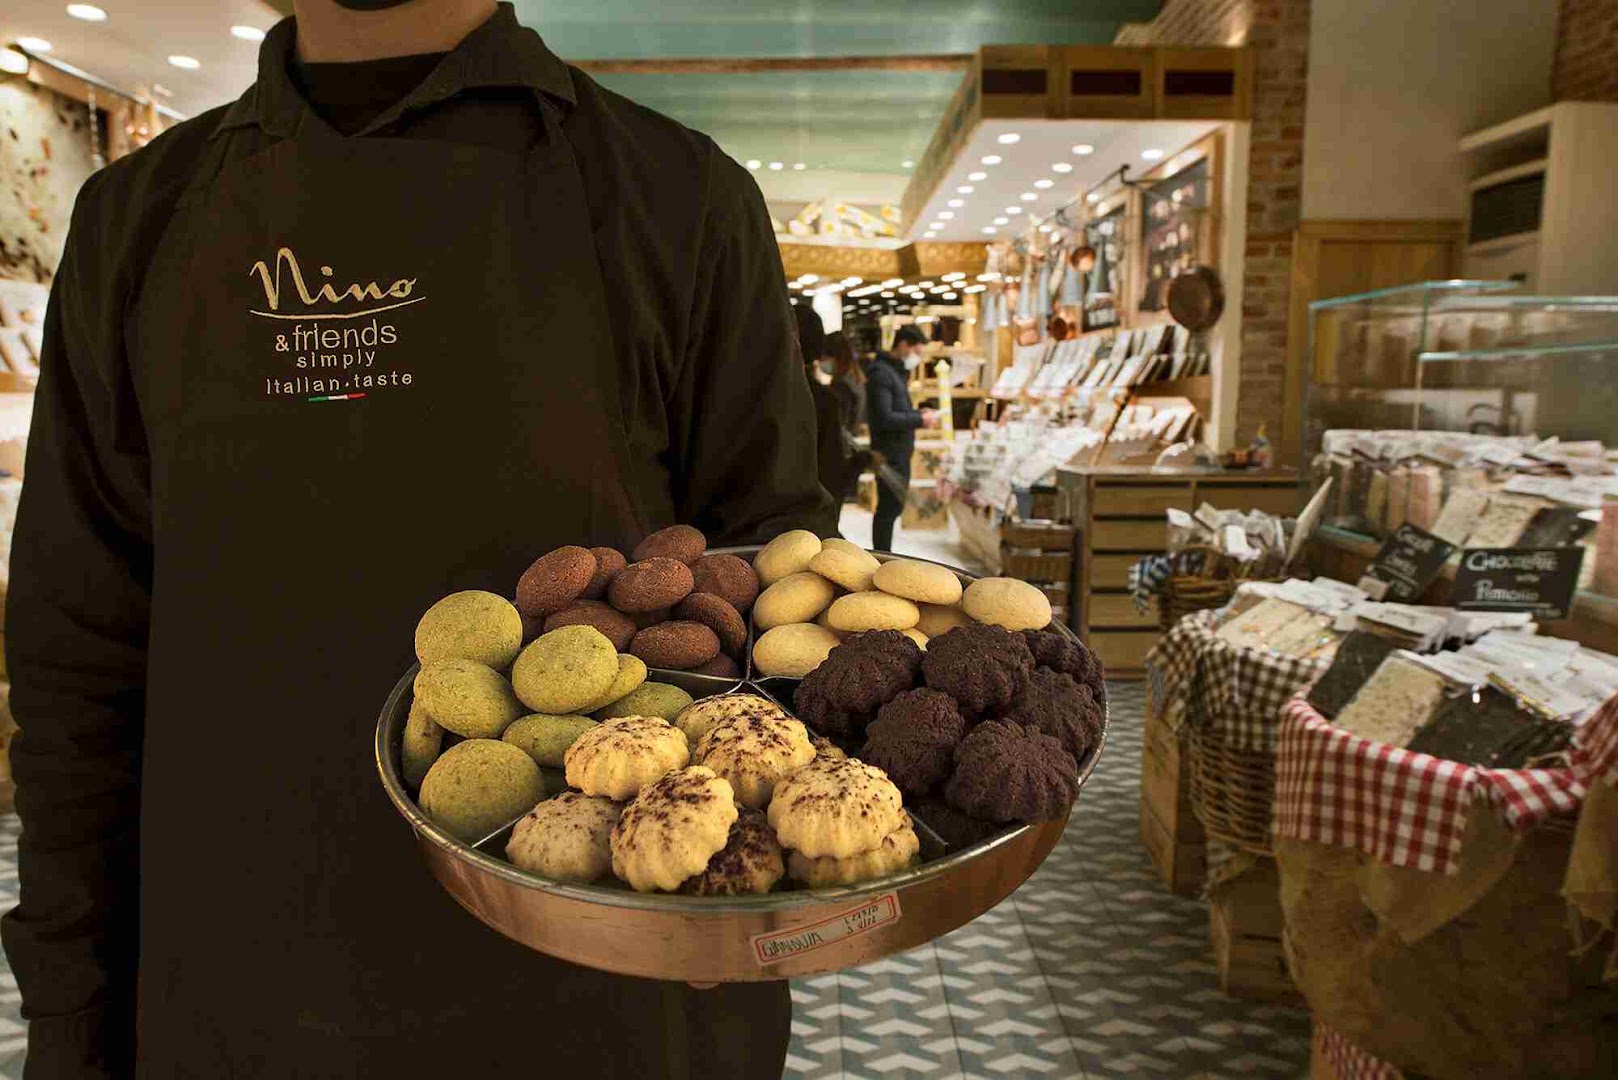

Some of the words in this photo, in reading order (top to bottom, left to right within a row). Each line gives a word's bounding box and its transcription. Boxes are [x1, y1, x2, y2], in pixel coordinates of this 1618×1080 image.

[249, 247, 417, 311] Nino
[275, 334, 289, 352] &
[292, 318, 397, 352] friends
[296, 349, 376, 369] simply
[353, 371, 413, 388] taste
